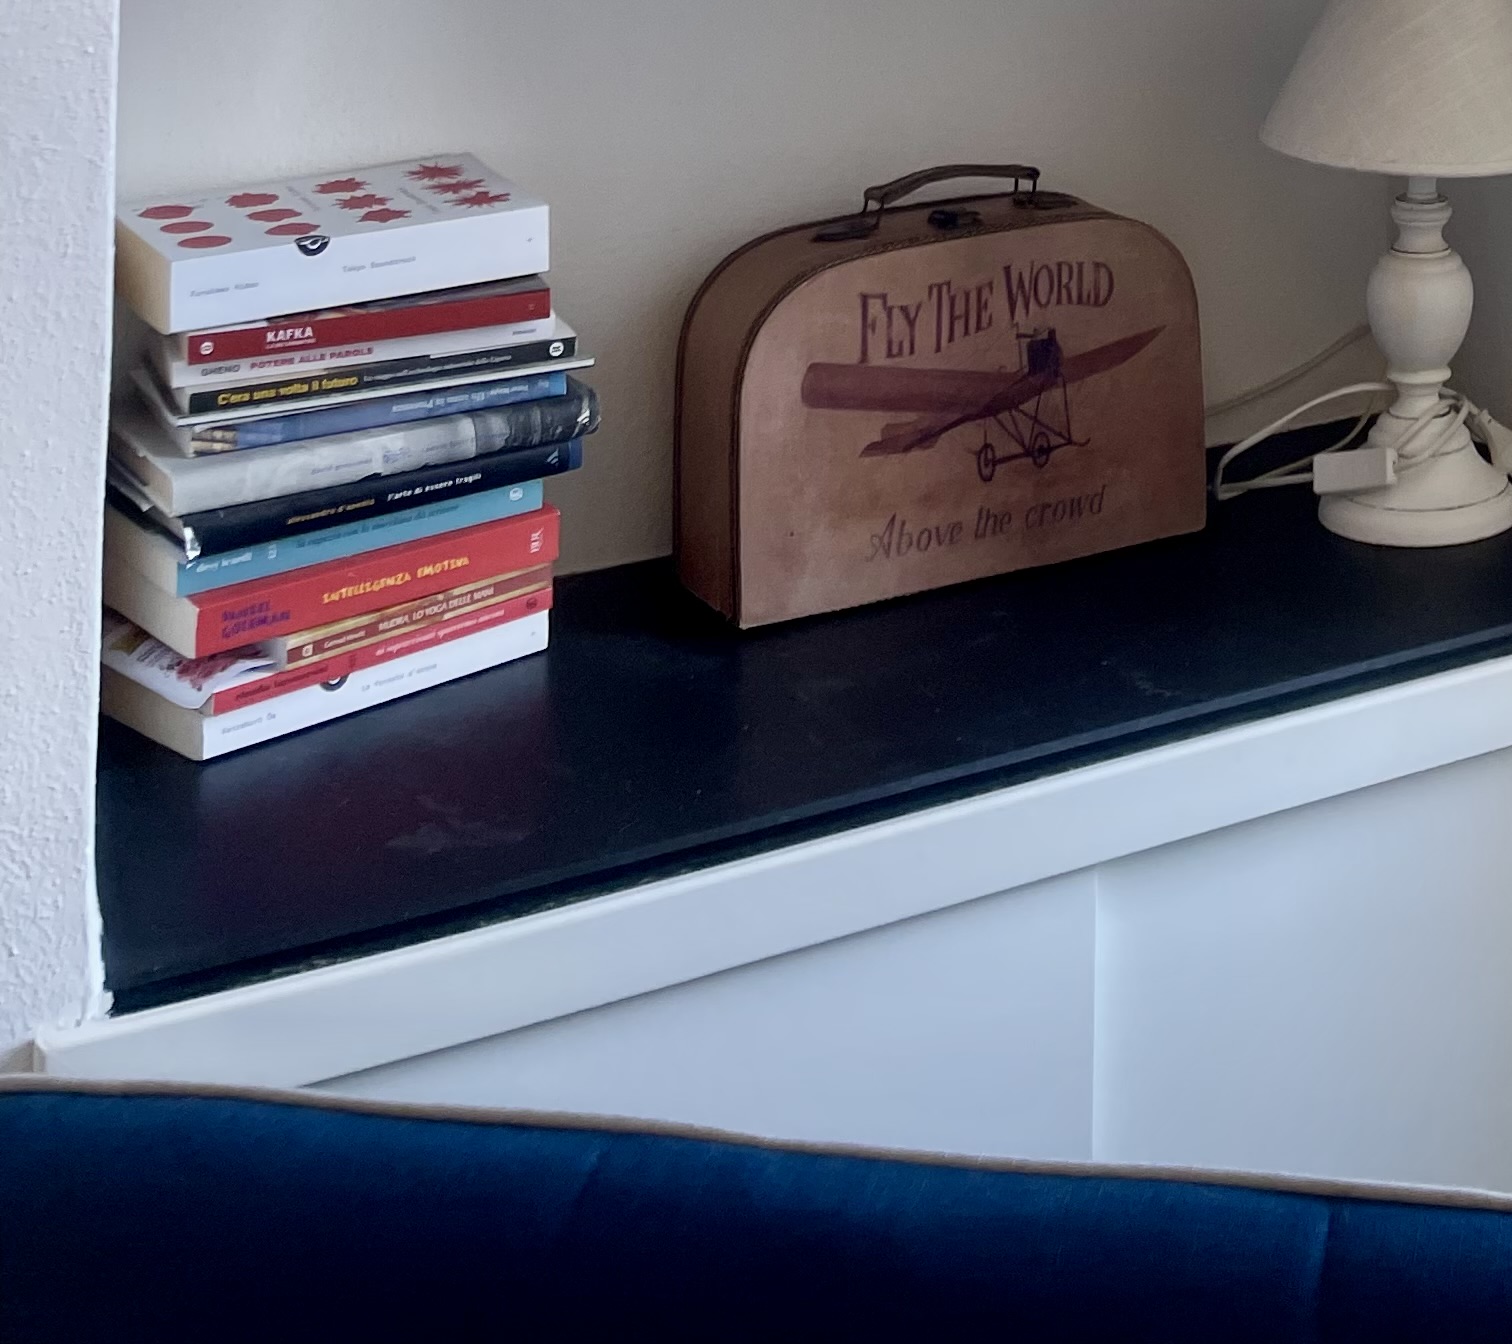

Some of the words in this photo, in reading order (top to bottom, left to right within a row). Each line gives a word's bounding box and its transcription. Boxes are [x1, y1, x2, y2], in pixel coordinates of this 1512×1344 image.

[857, 290, 921, 366] FLY
[928, 279, 994, 354] THE
[1003, 258, 1115, 323] WORLD
[266, 326, 314, 343] KAFKA
[250, 356, 295, 370] POTERE
[297, 352, 327, 364] ALLE
[330, 346, 374, 360] PAROLE
[217, 391, 251, 407] C'era
[253, 388, 277, 400] una
[279, 382, 310, 396] volta
[322, 375, 359, 390] futuro
[865, 512, 964, 564] Above
[974, 503, 1013, 541] the
[1023, 484, 1107, 533] crowd
[322, 572, 412, 604] INTELLIGENZA
[417, 556, 470, 579] EMOTIVA
[425, 601, 449, 618] YOGA
[449, 594, 472, 610] DELLE
